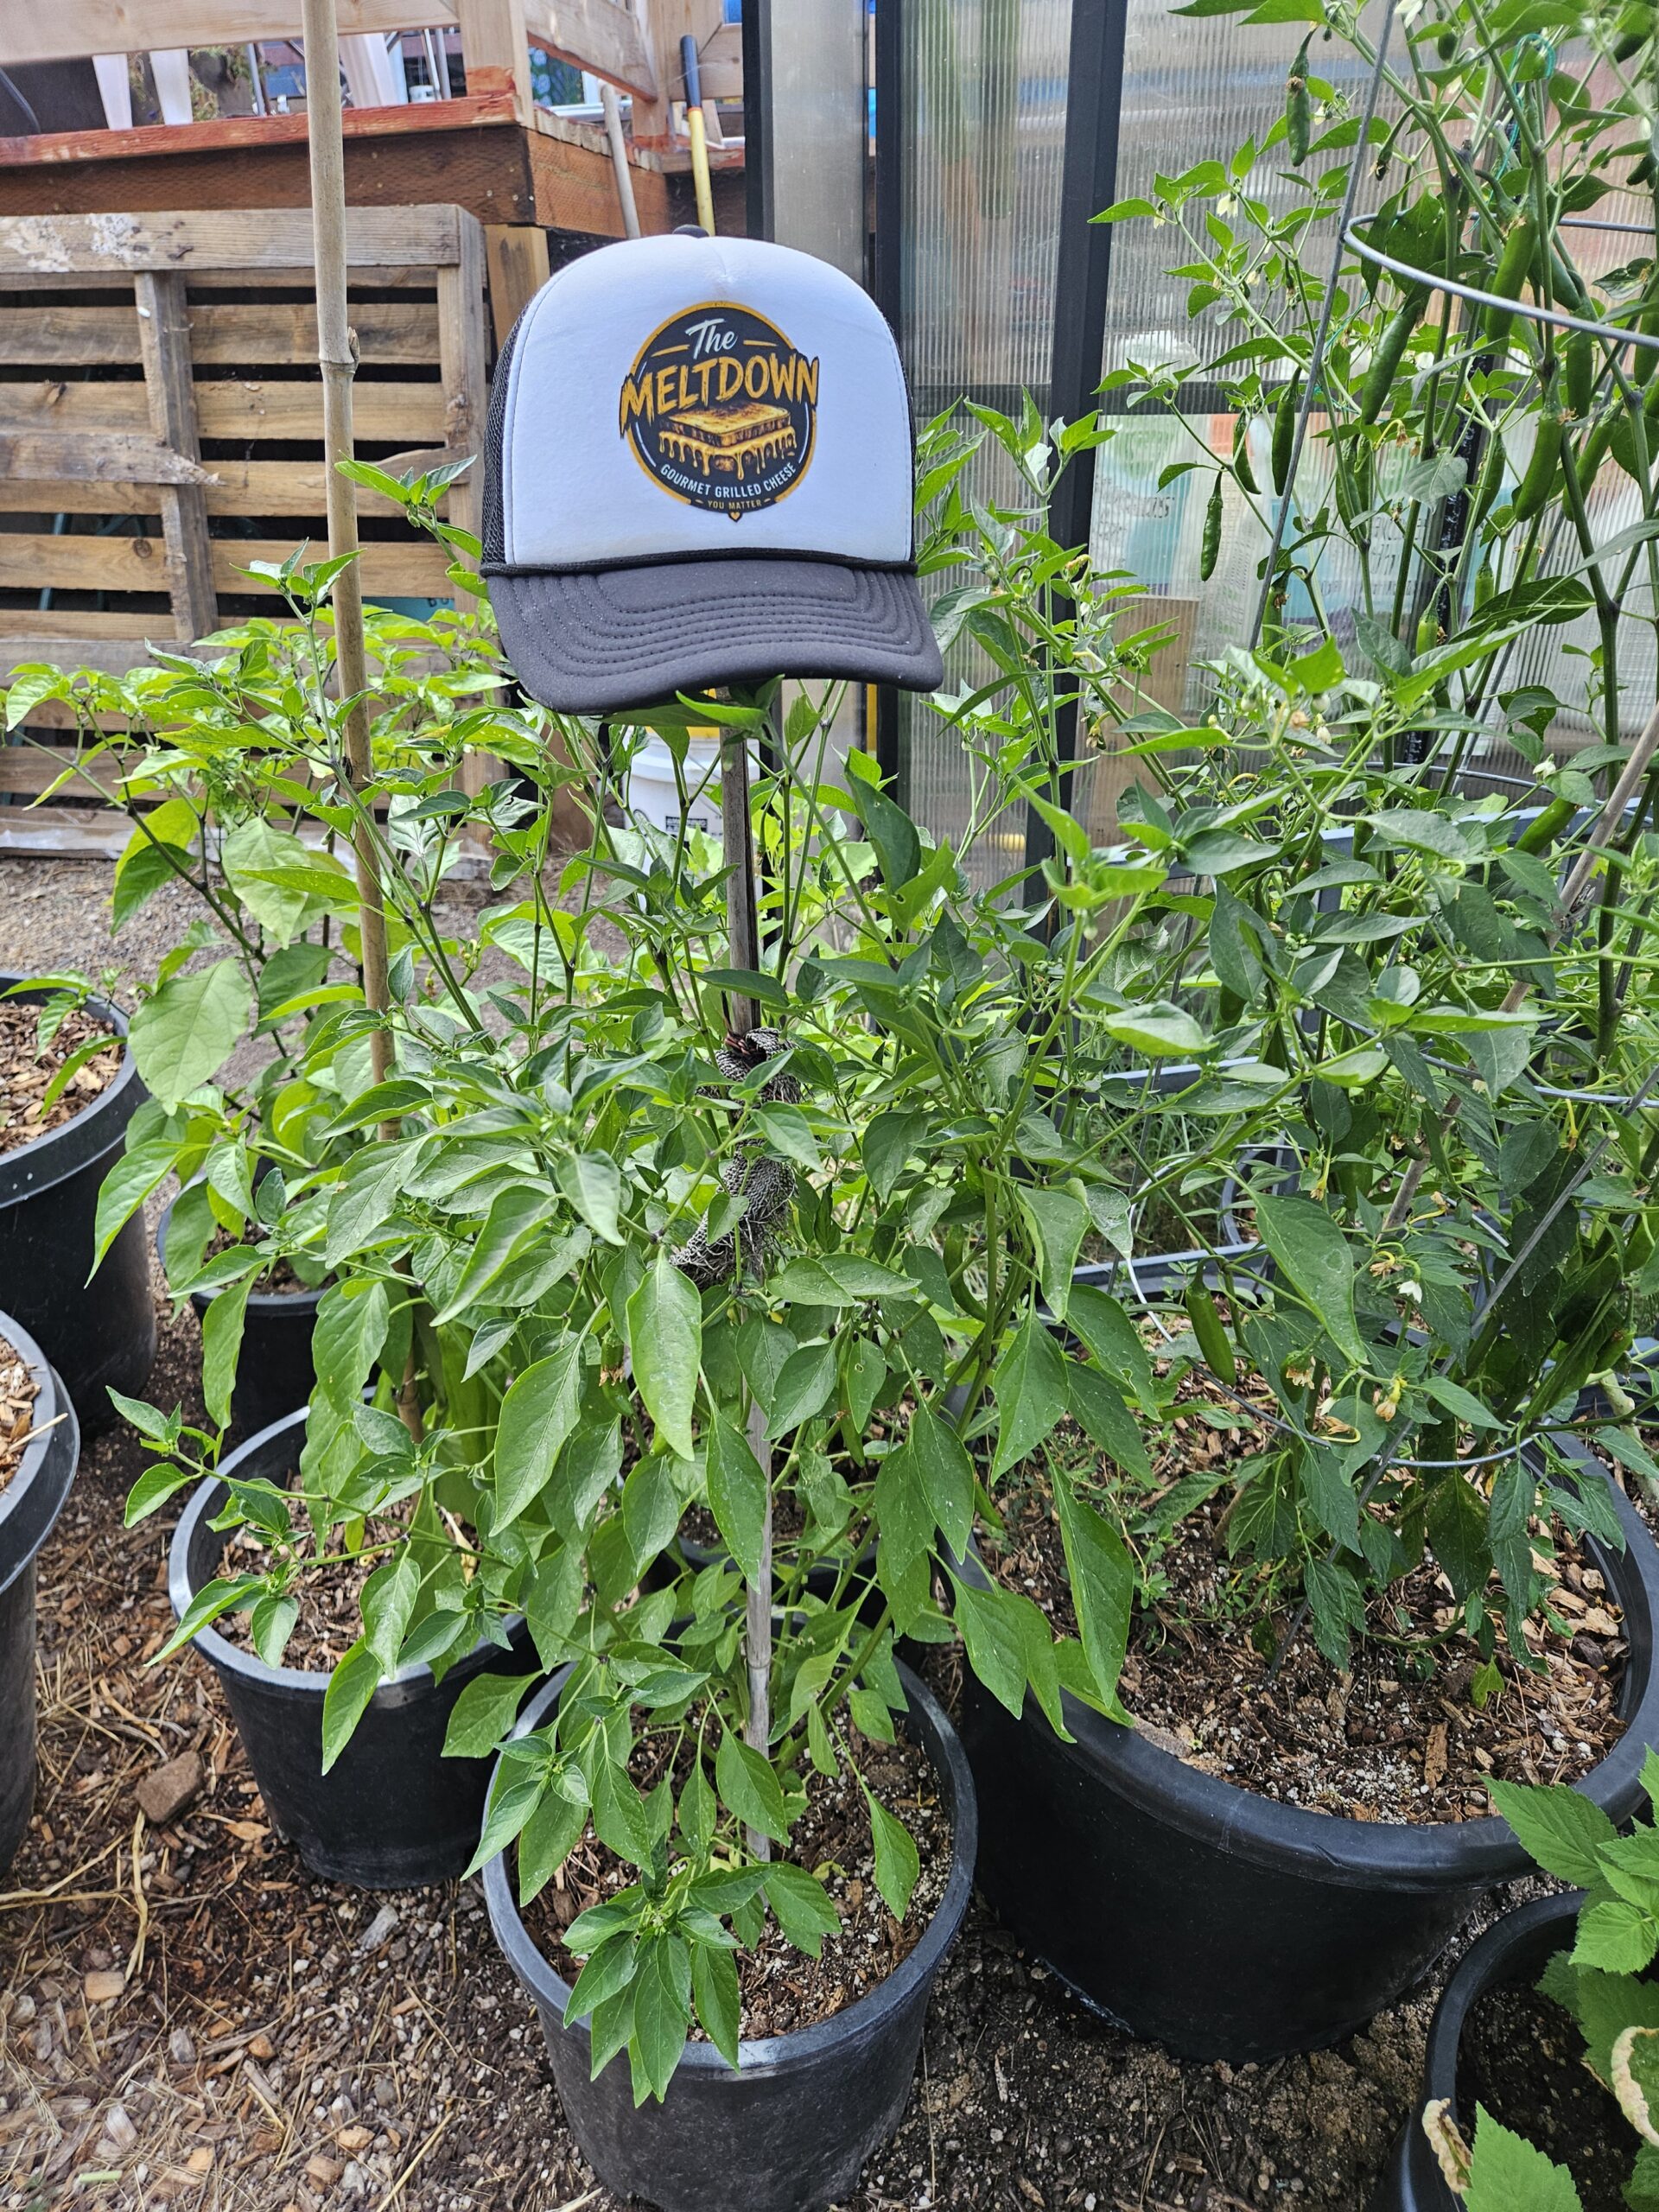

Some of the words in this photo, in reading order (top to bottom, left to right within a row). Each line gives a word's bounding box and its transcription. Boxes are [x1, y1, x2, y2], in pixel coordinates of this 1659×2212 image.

[685, 318, 738, 359] The
[620, 353, 819, 435] MELTDOWN
[660, 463, 711, 496] GOURMET
[715, 483, 762, 499] GRILLED
[764, 461, 797, 491] CHEESE
[708, 499, 725, 510] YOU
[728, 499, 762, 511] MATTER
